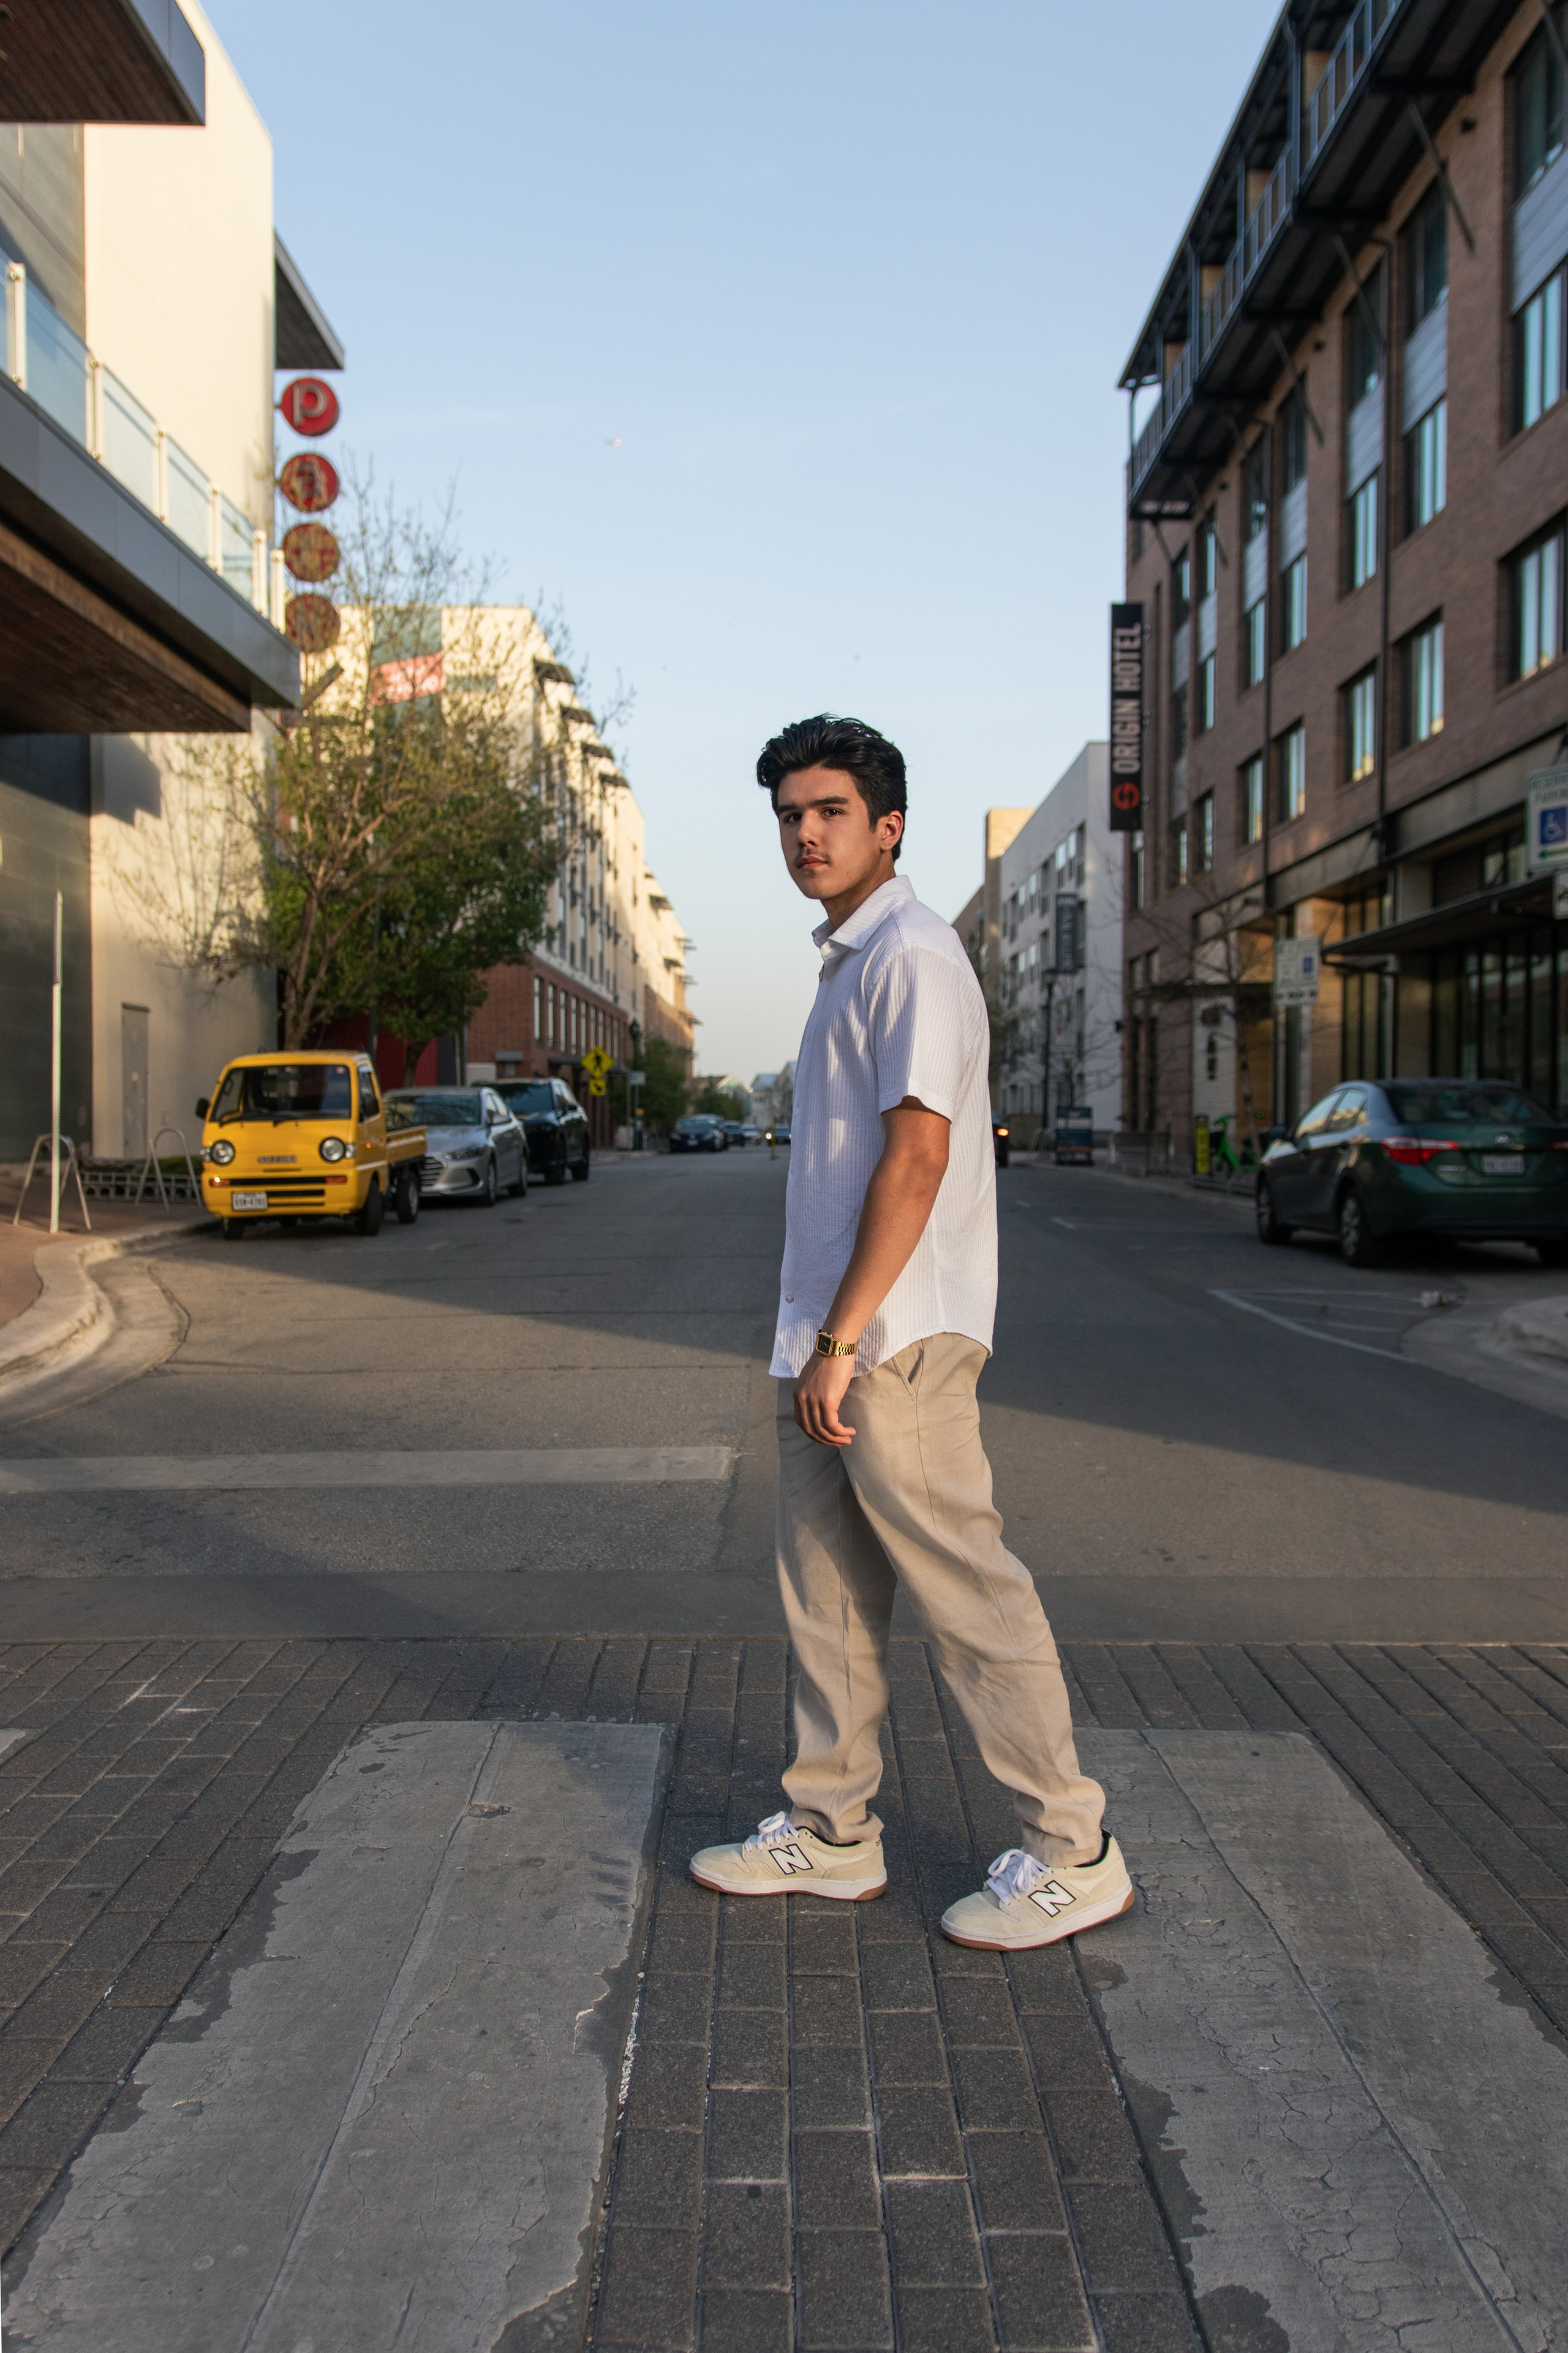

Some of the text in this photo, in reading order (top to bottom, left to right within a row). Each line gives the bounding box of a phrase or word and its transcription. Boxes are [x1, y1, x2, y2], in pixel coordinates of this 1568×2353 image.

[1113, 622, 1142, 774] ORIGIN HOTEL
[768, 1843, 814, 1875] N
[1027, 1879, 1077, 1917] N
